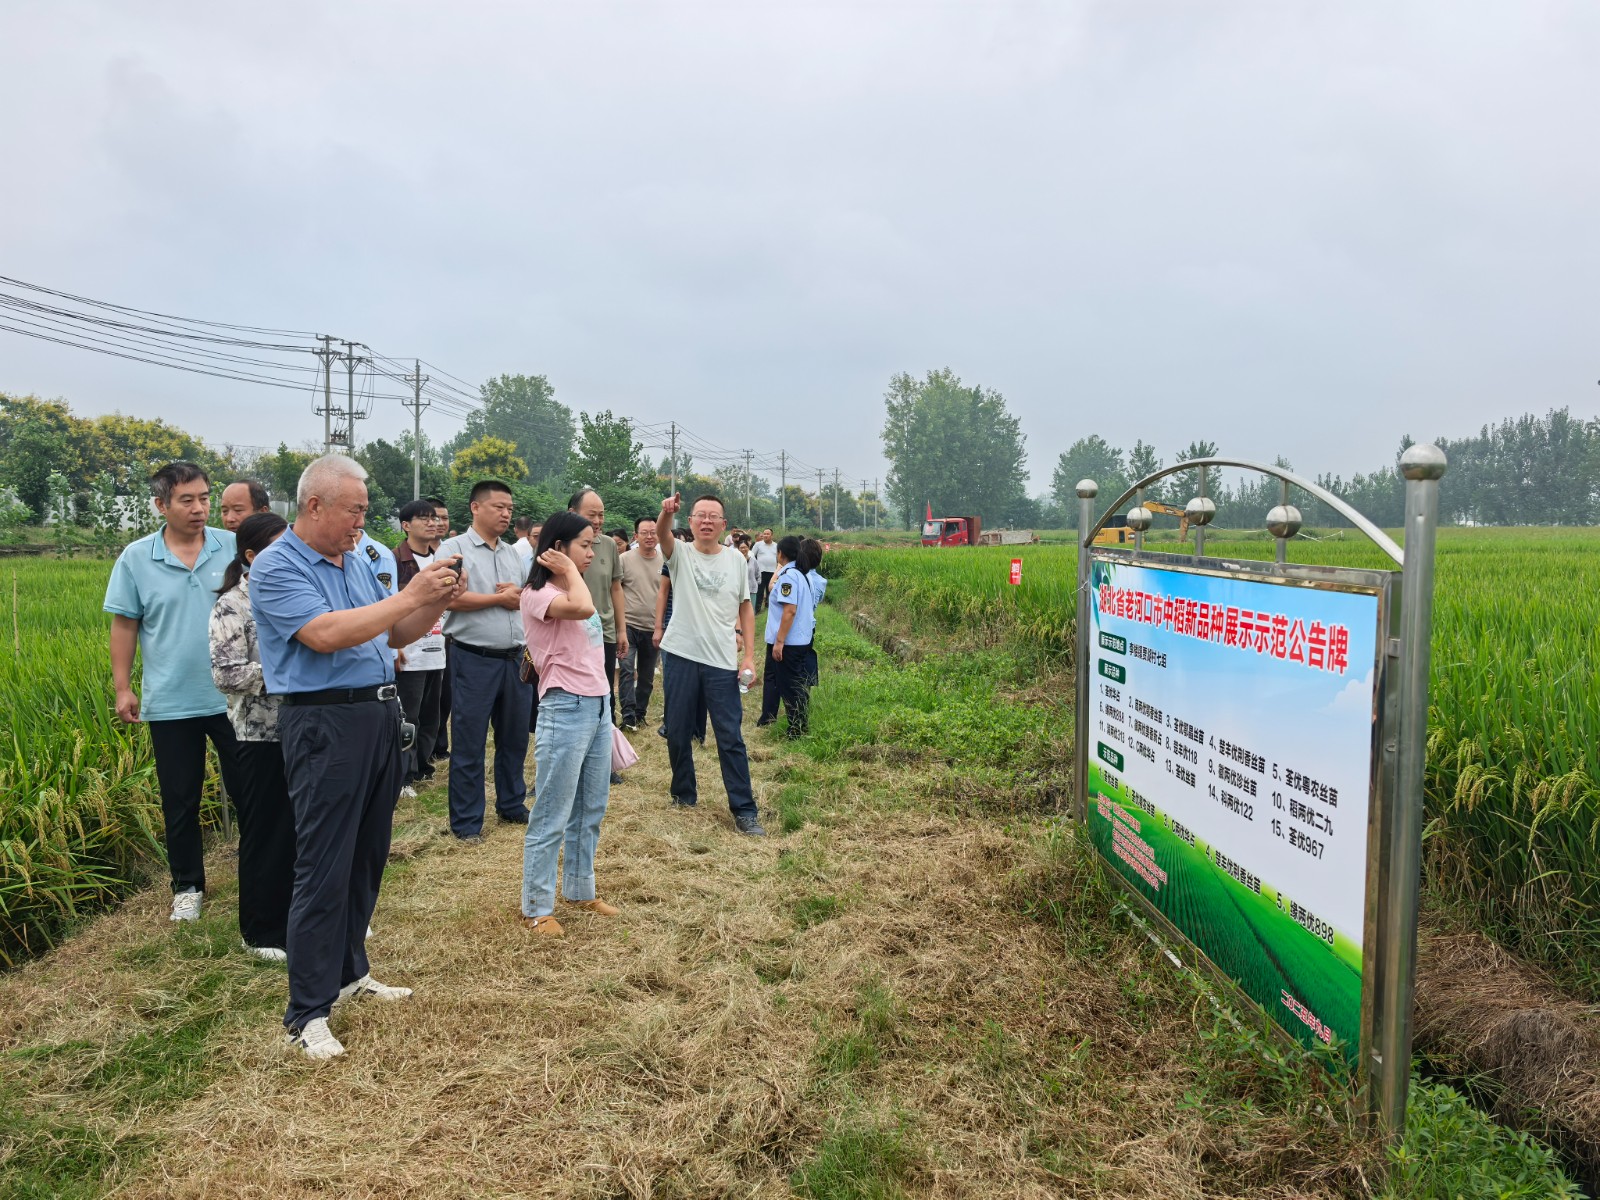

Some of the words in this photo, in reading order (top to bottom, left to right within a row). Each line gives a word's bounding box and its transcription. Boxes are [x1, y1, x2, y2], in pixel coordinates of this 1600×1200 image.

[1098, 583, 1349, 674] 湖北省老河口市中稻新品种展示示范公告牌
